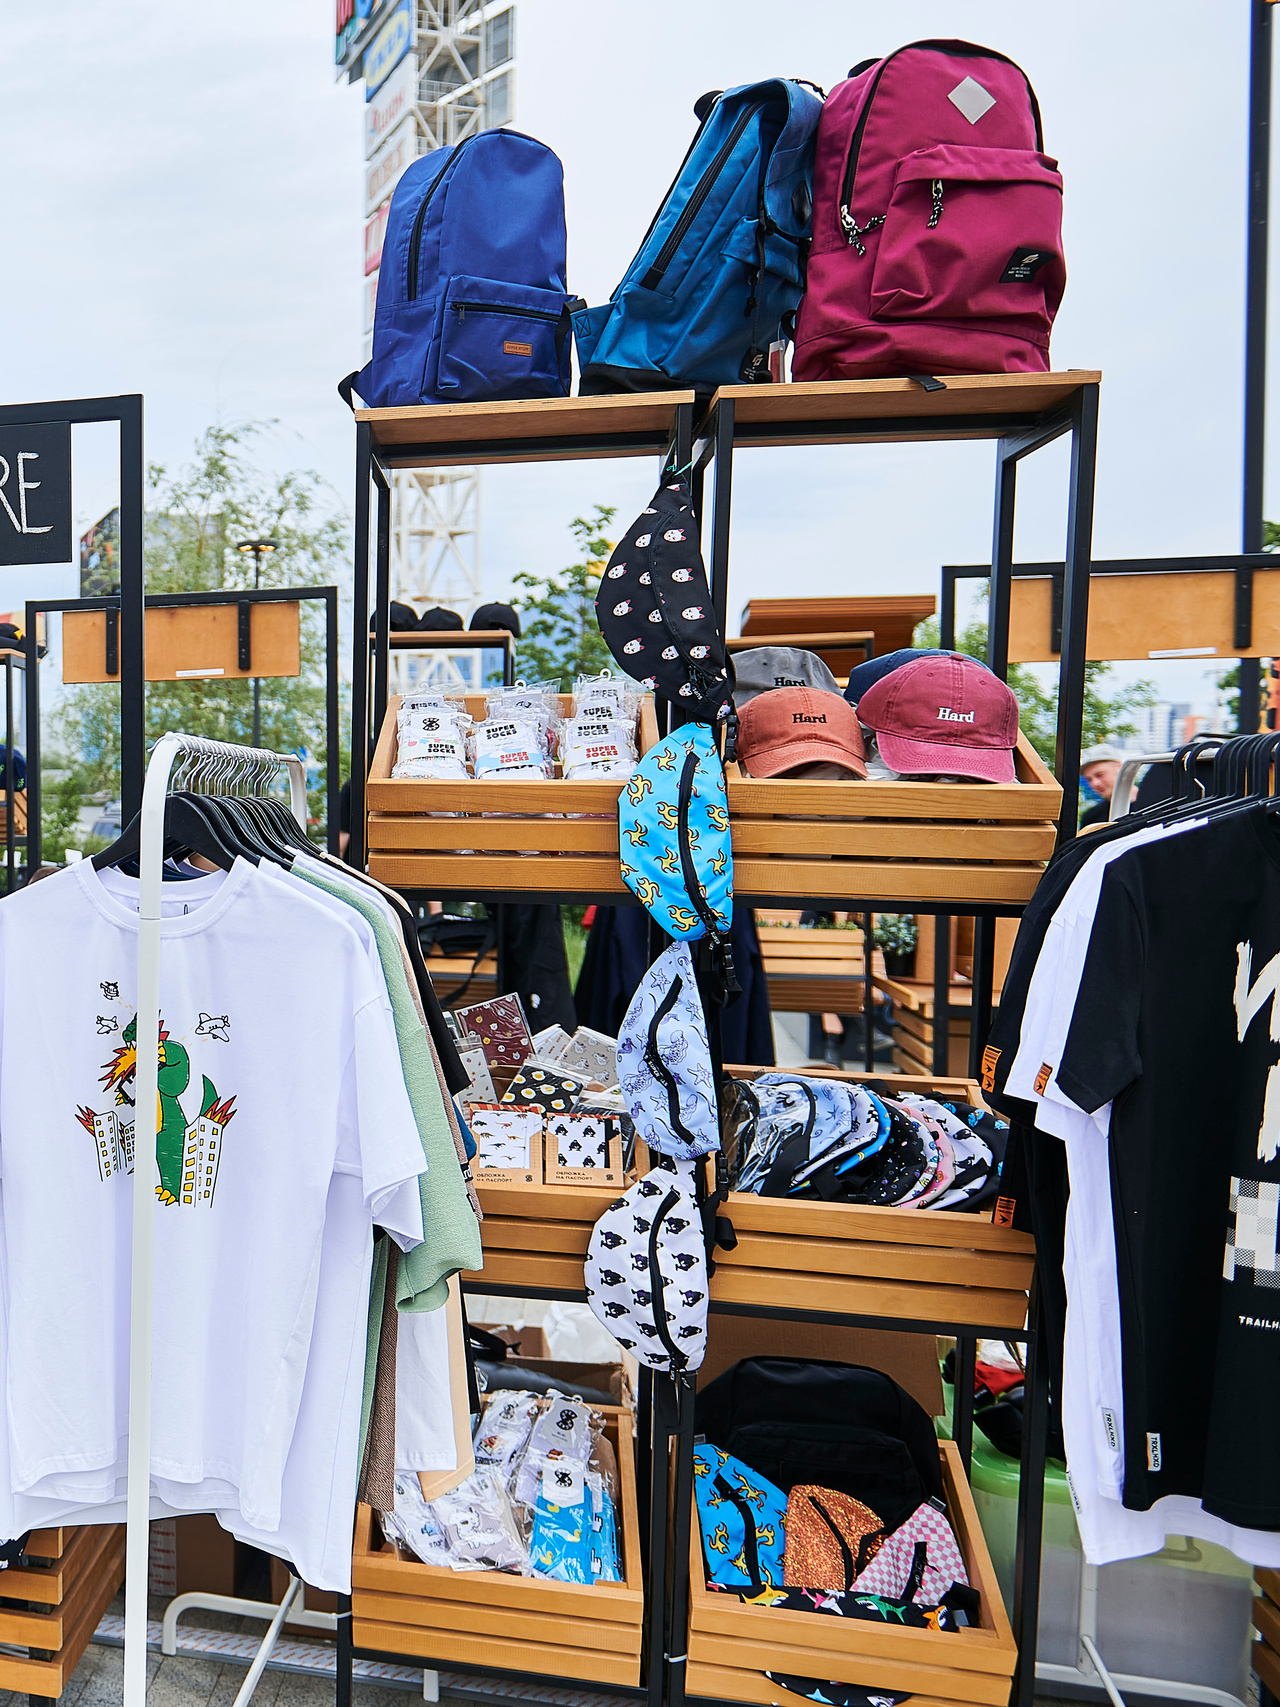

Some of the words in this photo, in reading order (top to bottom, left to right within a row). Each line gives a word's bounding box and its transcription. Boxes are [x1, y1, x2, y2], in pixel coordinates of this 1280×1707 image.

[774, 677, 806, 687] Hard
[583, 706, 612, 716] SUPER
[937, 707, 975, 723] Hard
[792, 712, 827, 724] Hard
[486, 724, 515, 734] SUPER
[486, 729, 518, 740] SOCKS
[586, 745, 616, 753] SUPER
[500, 751, 527, 759] SUPER
[500, 756, 529, 764] SOCKS
[1238, 1315, 1280, 1330] TRAILH
[1150, 1436, 1160, 1468] TRXLHXD
